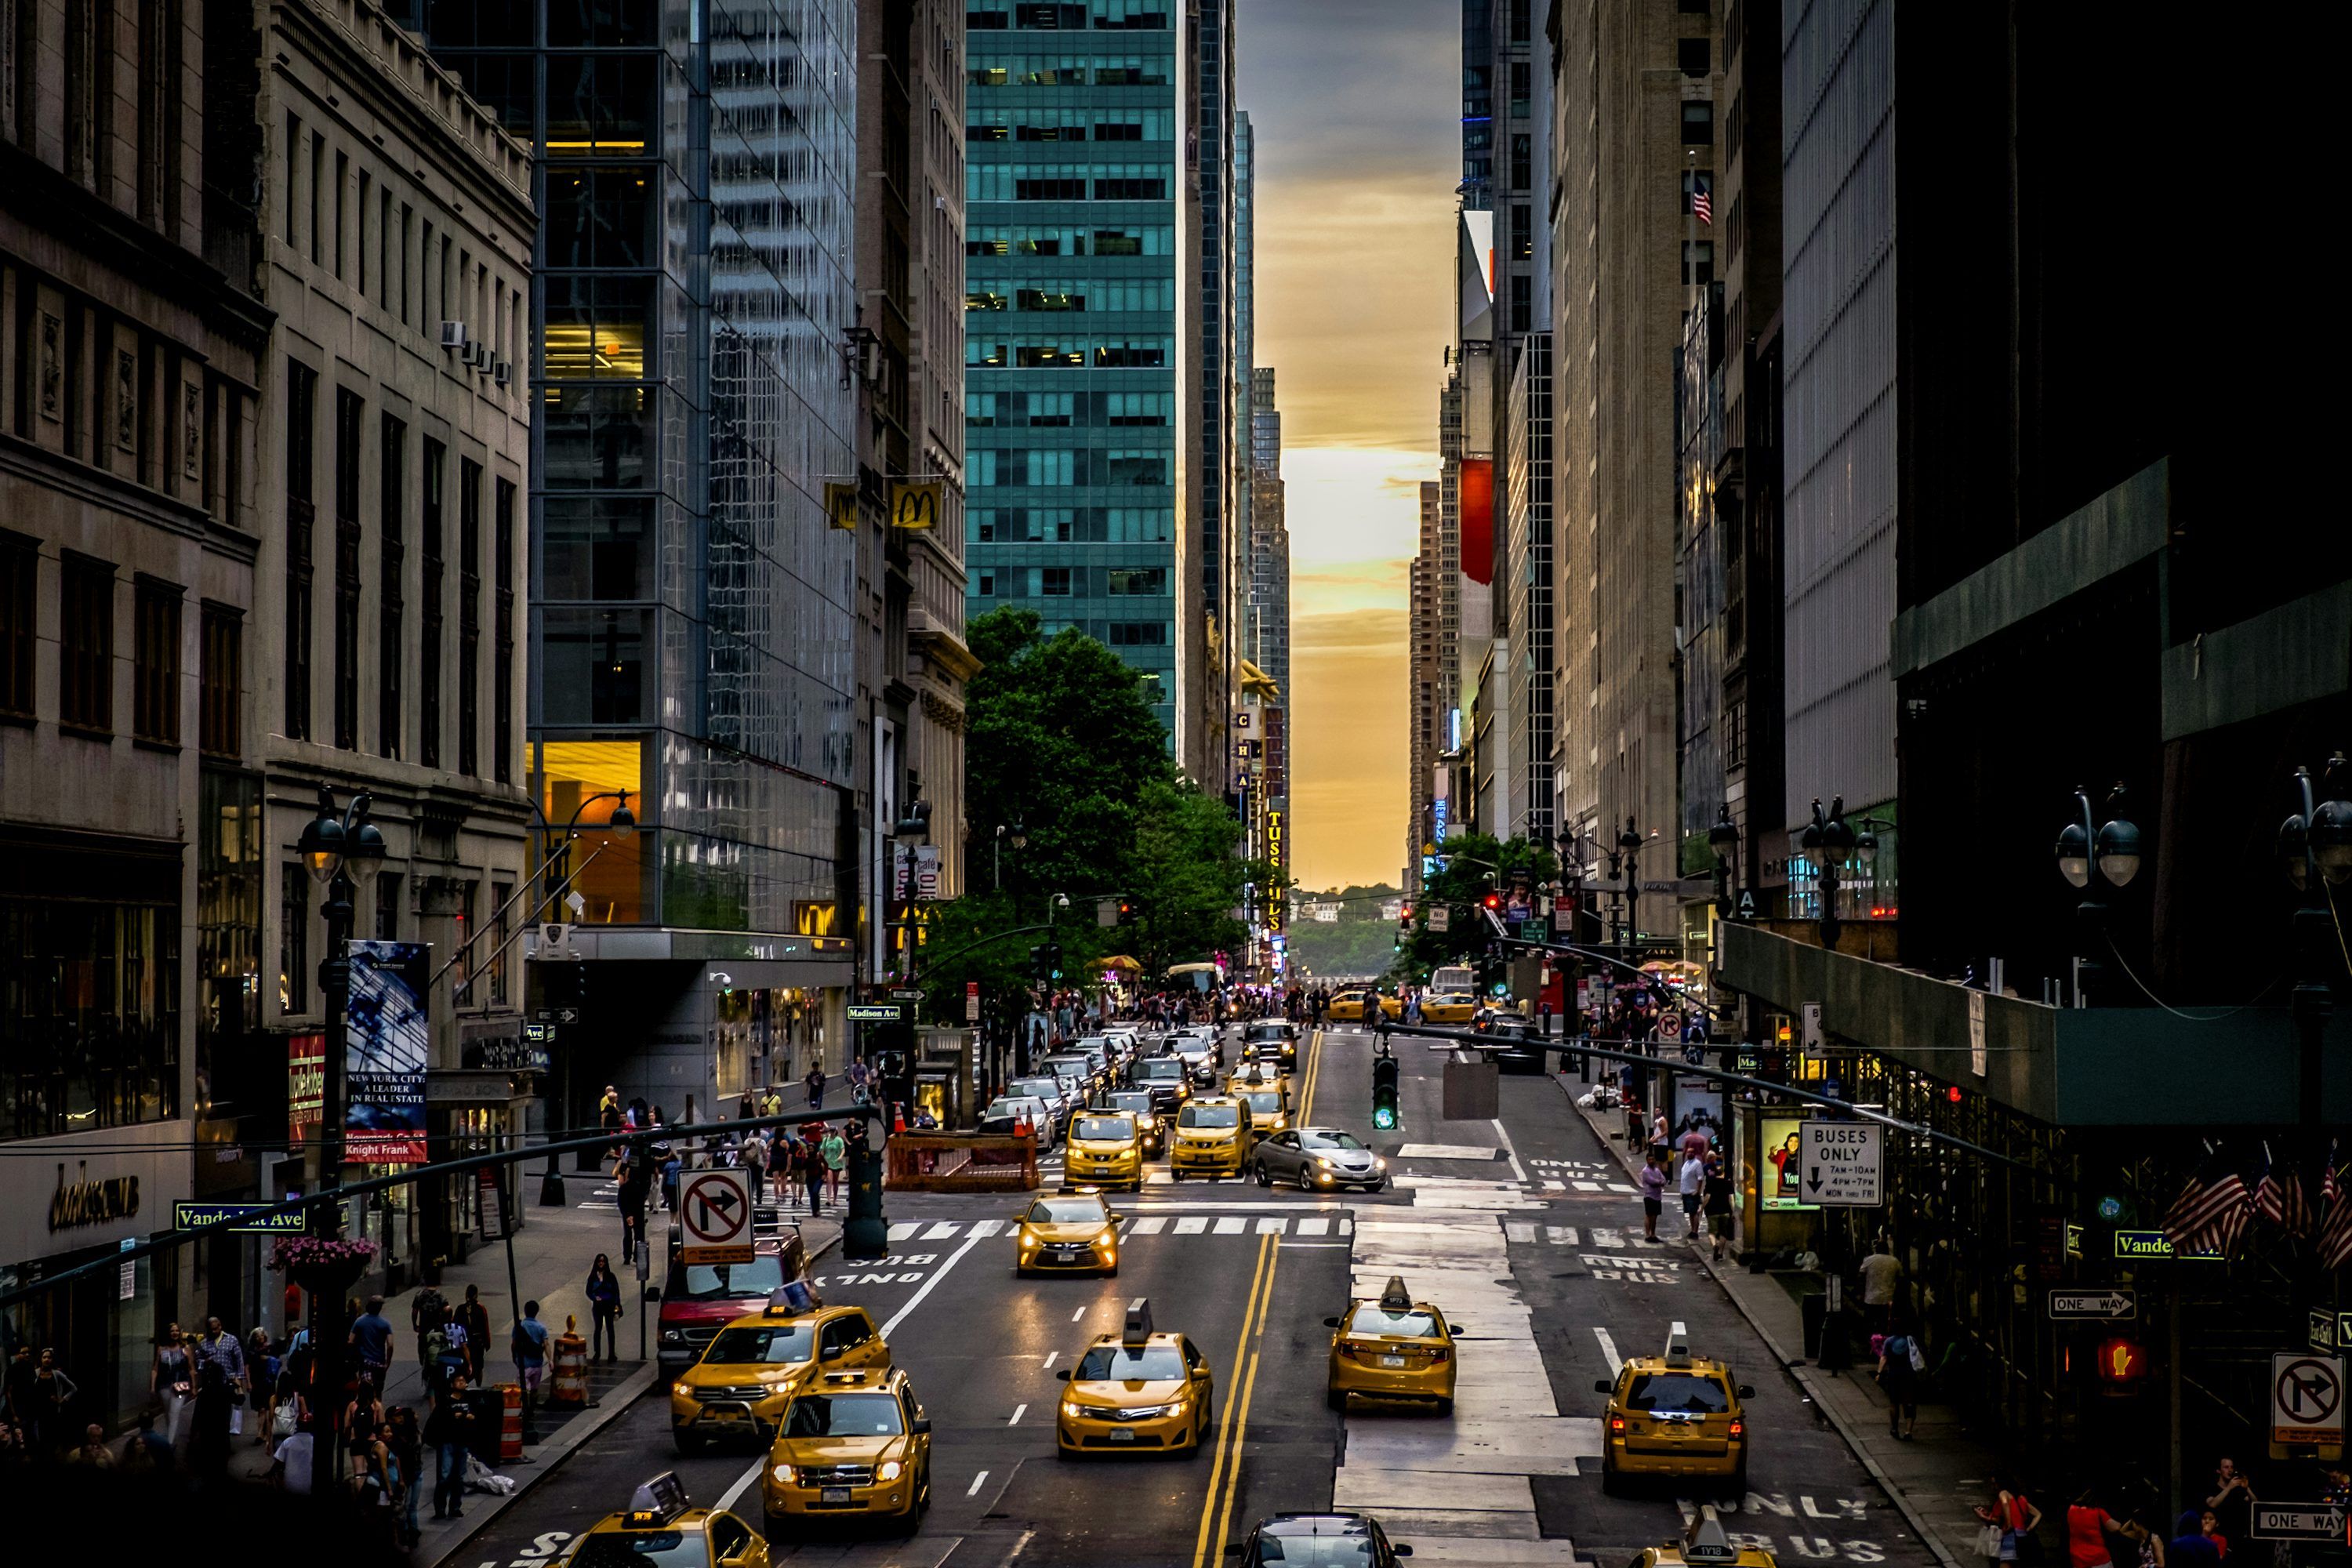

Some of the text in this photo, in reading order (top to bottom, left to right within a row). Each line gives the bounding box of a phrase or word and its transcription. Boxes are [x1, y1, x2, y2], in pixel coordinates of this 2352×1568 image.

[849, 1008, 898, 1018] Madison Ave
[527, 1029, 543, 1038] Ave
[400, 1075, 426, 1083] CITY:
[350, 1094, 424, 1103] IN REAL ESTATE
[1815, 1130, 1867, 1143] BUSES
[346, 1144, 408, 1156] Knight Frank
[1820, 1148, 1860, 1160] ONLY
[1530, 1160, 1610, 1169] ONLY
[1537, 1170, 1610, 1180] BUS
[1826, 1189, 1842, 1198] MON
[1862, 1189, 1875, 1198] FRI
[270, 1213, 303, 1226] Ave
[1583, 1257, 1679, 1271] ONLY
[1593, 1270, 1681, 1284] BUS
[2057, 1299, 2125, 1309] ONE WAY
[2268, 1514, 2343, 1530] ONE WAY
[1700, 1546, 1723, 1556] 1Y18
